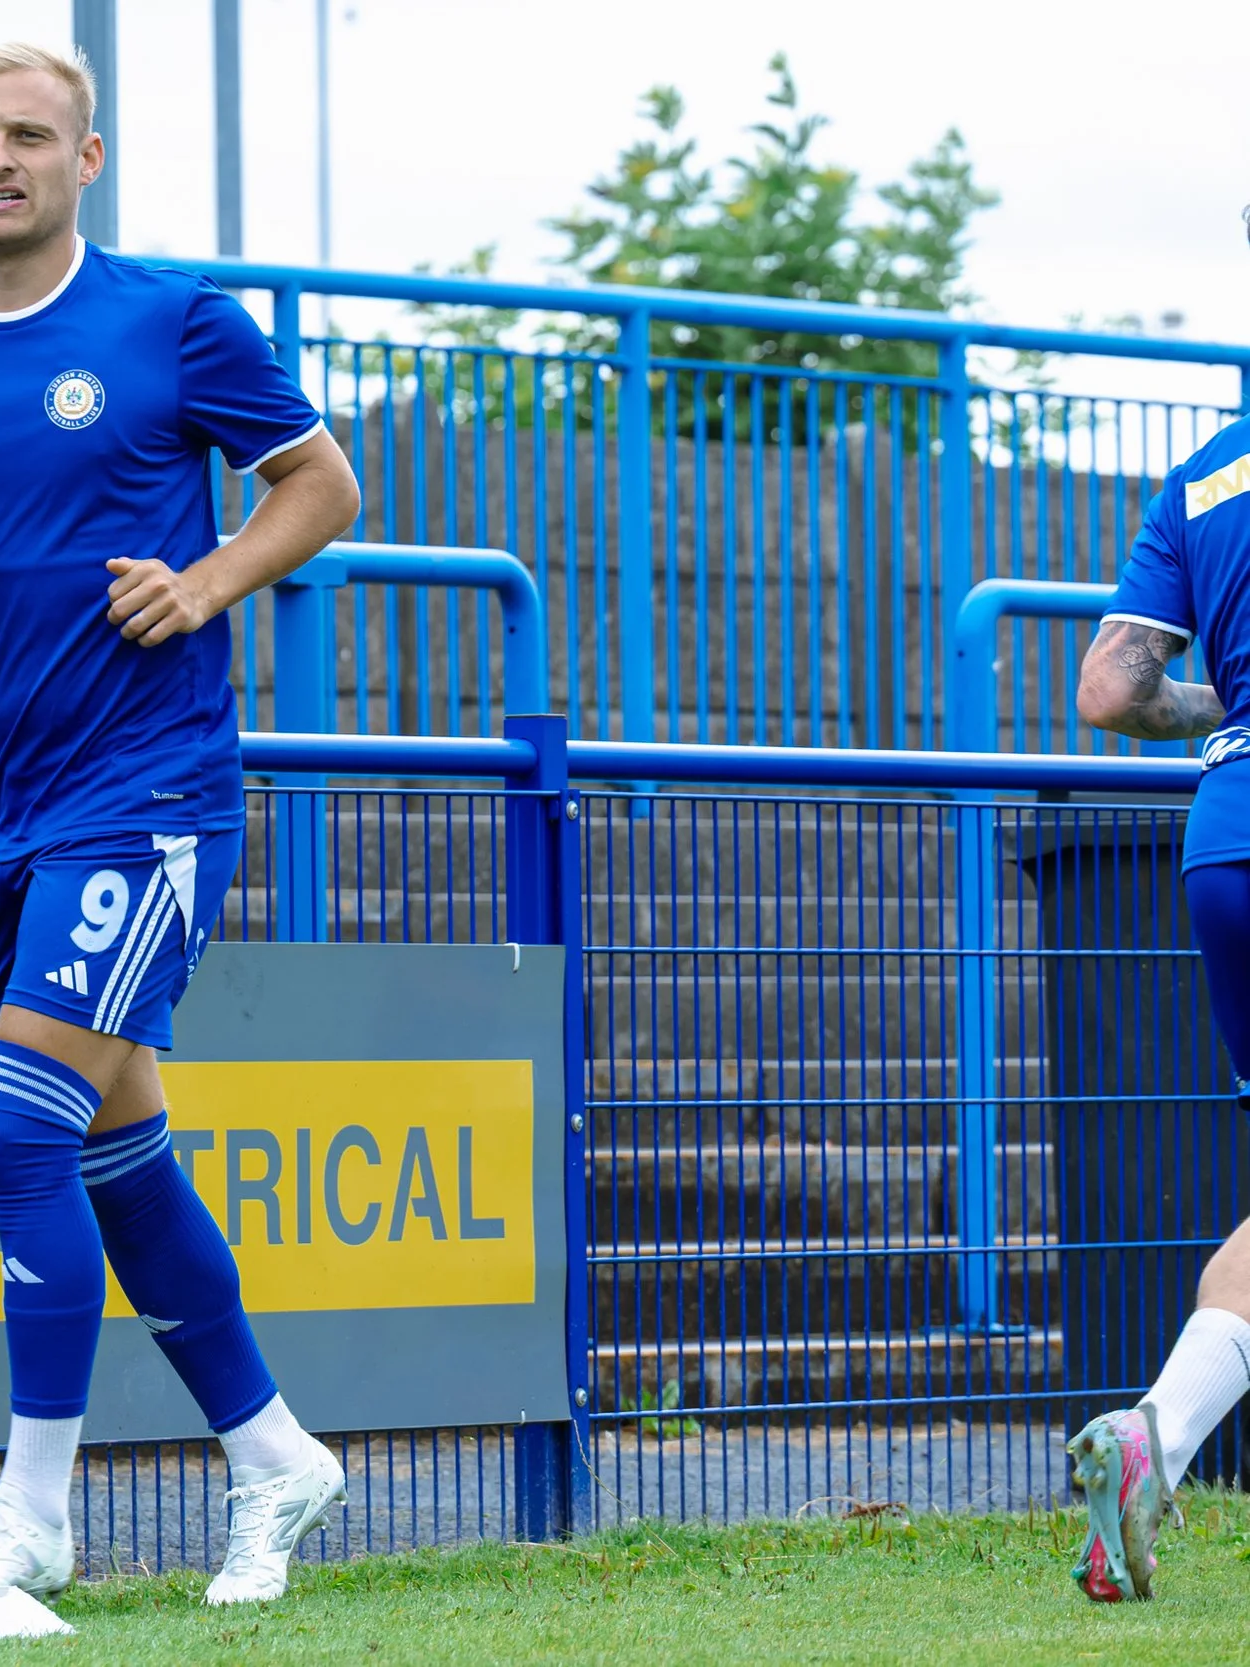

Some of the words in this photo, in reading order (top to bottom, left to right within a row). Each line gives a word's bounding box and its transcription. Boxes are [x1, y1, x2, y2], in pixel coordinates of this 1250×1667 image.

[49, 372, 75, 393] CURZON
[77, 372, 101, 394] ASHTON
[48, 406, 81, 427] FOOTBALL
[82, 406, 99, 423] CLUB
[69, 869, 130, 953] 9
